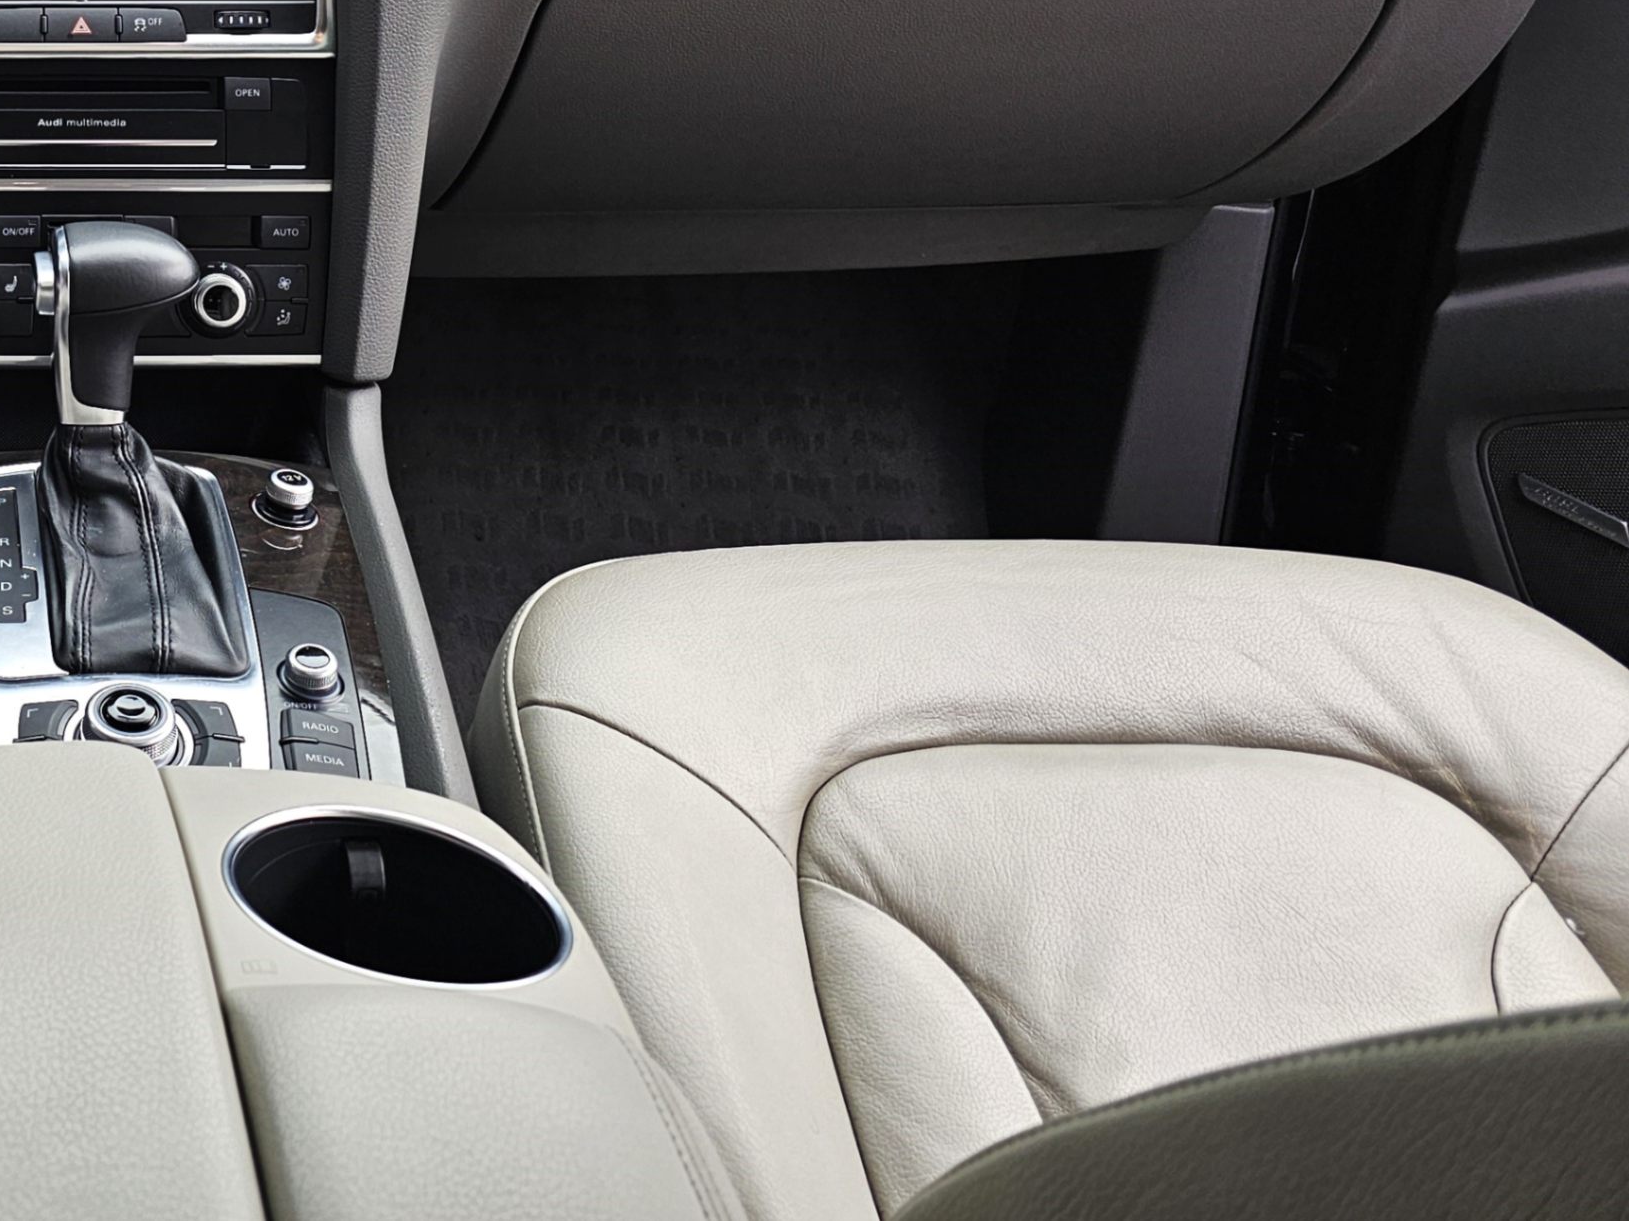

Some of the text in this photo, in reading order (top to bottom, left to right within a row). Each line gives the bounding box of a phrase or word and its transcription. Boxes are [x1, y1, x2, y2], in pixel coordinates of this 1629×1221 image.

[148, 17, 163, 26] OFF
[235, 88, 260, 98] OPEN
[37, 118, 127, 127] Audi multimedia
[2, 227, 35, 236] ON/OFF
[273, 228, 299, 236] AUTO
[0, 538, 10, 547] R
[0, 559, 12, 568] N
[0, 582, 13, 592] D
[2, 606, 13, 616] S
[302, 721, 339, 734] RADIO
[305, 753, 345, 766] MEDIA
